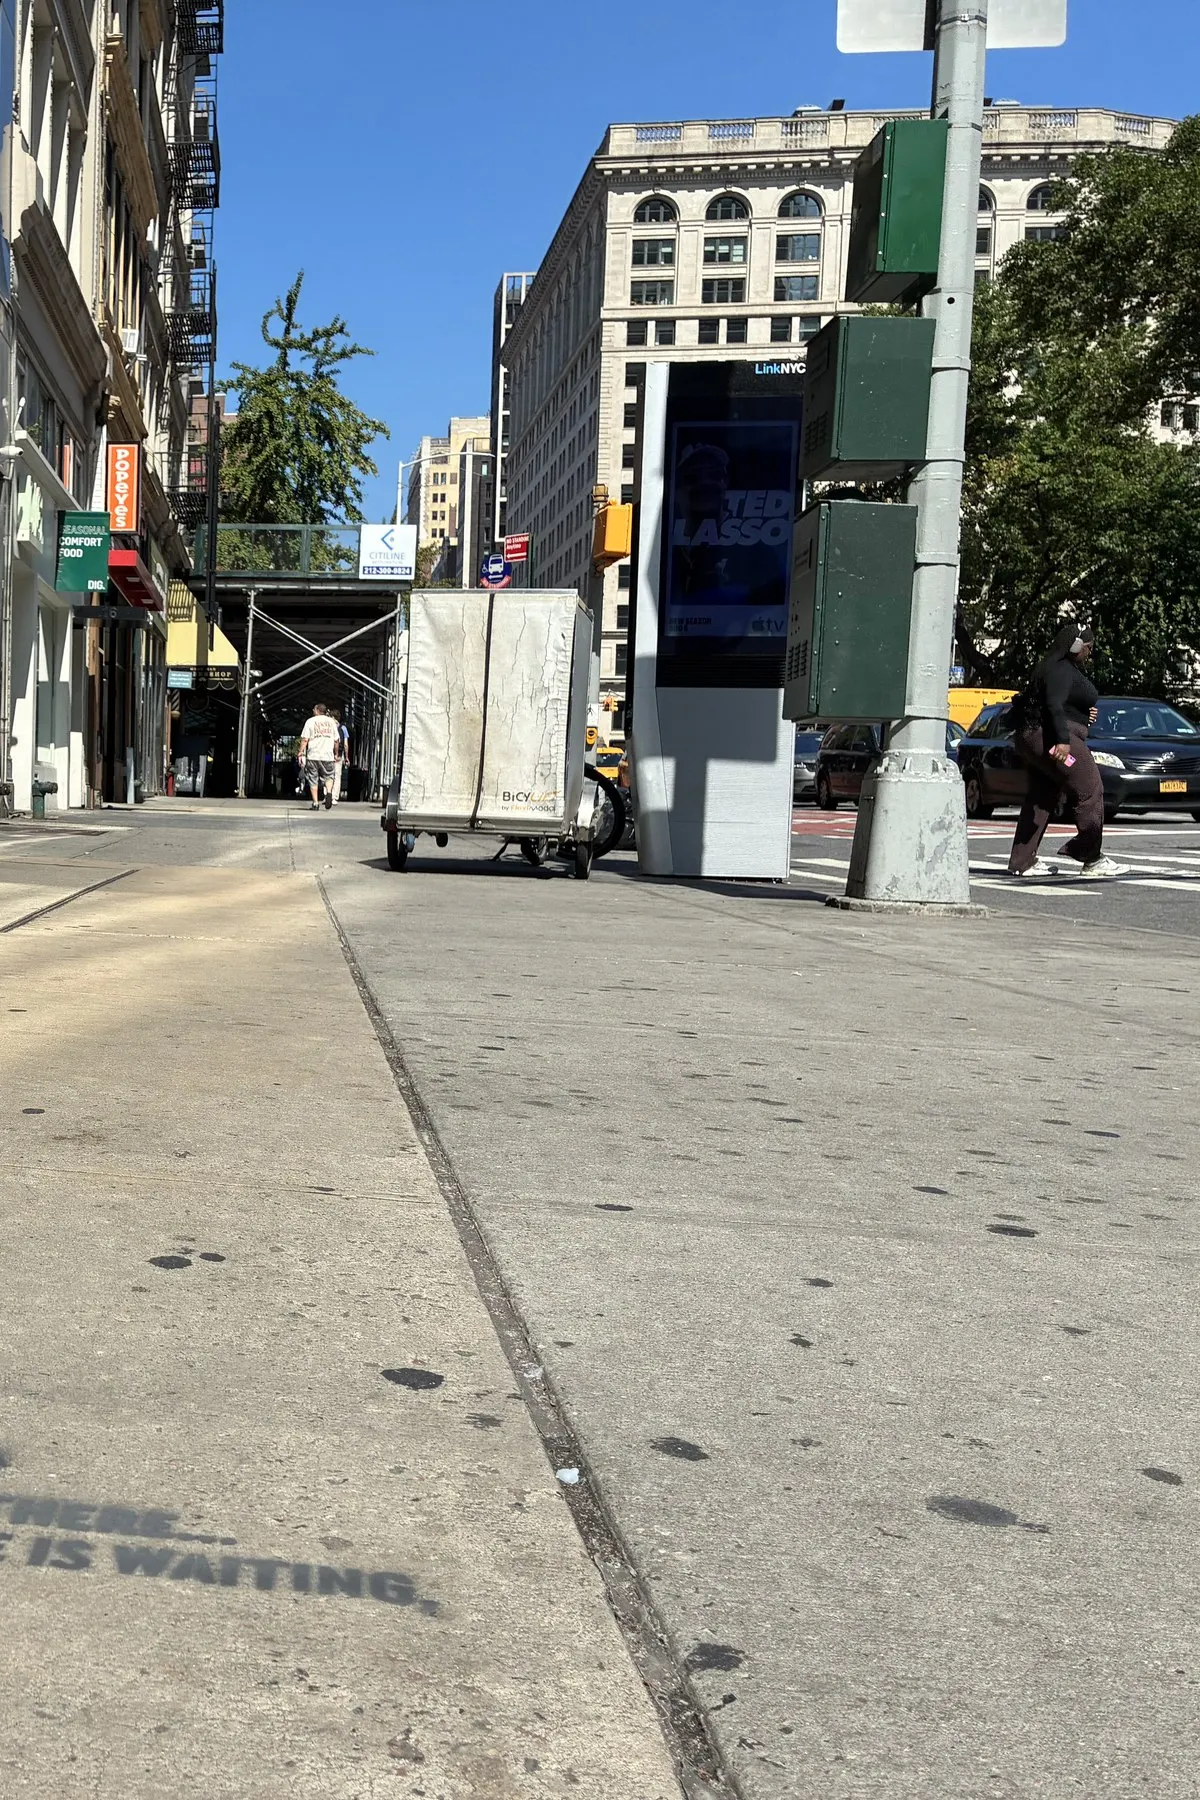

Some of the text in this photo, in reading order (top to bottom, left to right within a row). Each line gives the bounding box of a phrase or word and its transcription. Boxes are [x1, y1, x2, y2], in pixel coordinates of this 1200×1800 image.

[754, 362, 807, 375] LinkNYC
[725, 489, 791, 518] TED
[673, 518, 790, 546] LASSO
[59, 537, 103, 547] COMFORT
[59, 548, 84, 558] FOOD
[369, 551, 406, 561] CITILINE
[87, 580, 106, 590] DIG.
[767, 618, 785, 632] tv
[26, 1536, 93, 1571] IS
